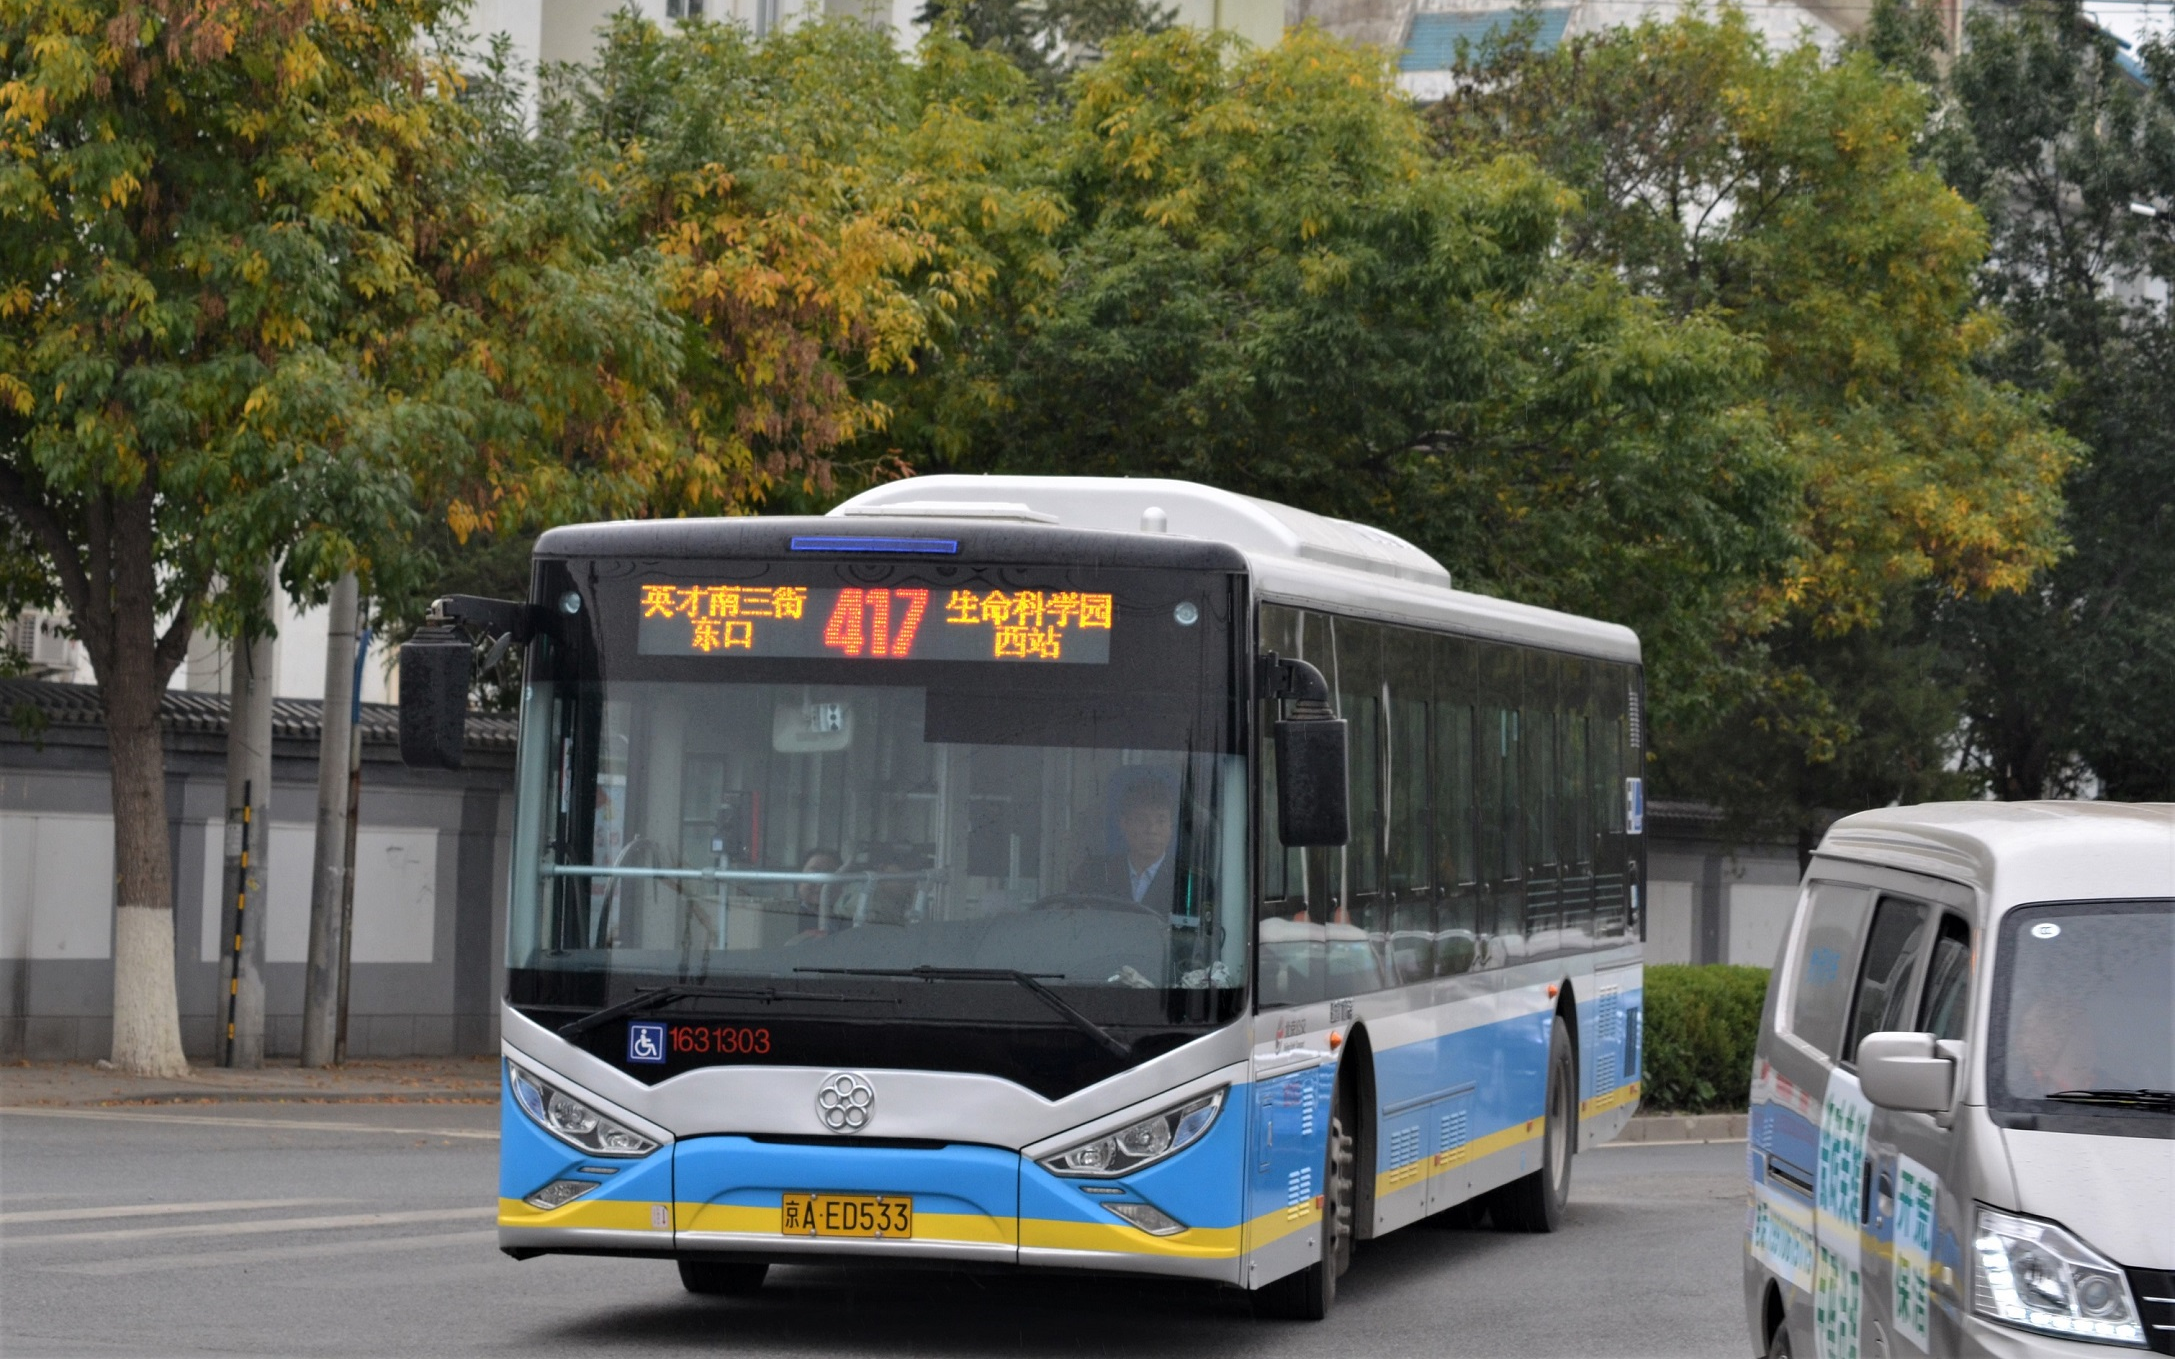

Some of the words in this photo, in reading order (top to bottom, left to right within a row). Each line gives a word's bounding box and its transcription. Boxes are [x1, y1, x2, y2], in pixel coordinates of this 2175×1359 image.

[641, 584, 807, 619] 英才南三街
[945, 589, 1112, 629] 生命科学园
[691, 616, 752, 652] 东口
[824, 587, 929, 657] 417
[994, 625, 1062, 659] 西站
[668, 1026, 771, 1055] 1631303
